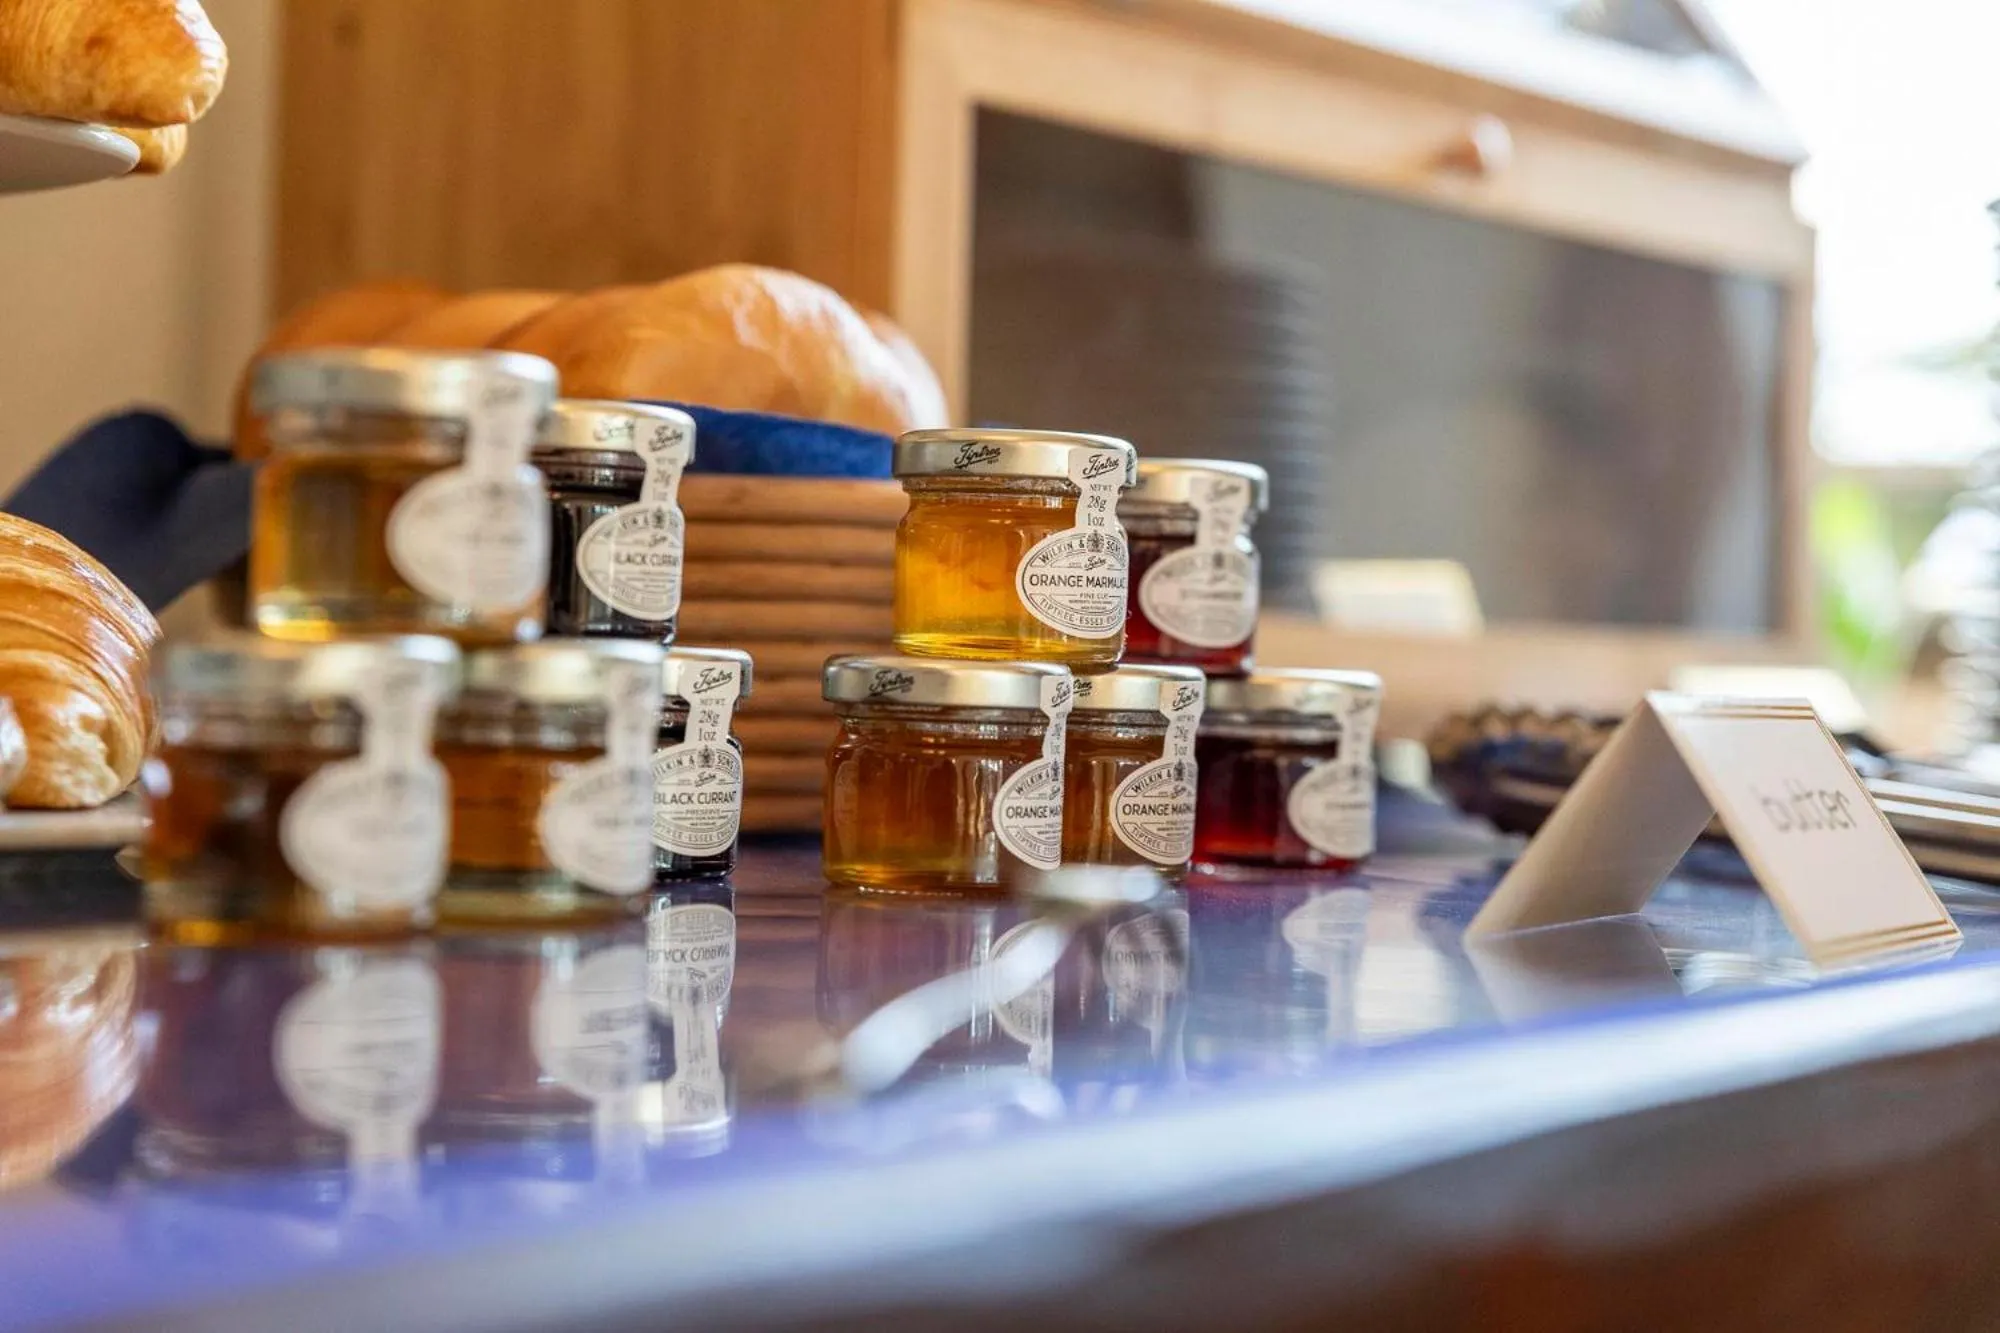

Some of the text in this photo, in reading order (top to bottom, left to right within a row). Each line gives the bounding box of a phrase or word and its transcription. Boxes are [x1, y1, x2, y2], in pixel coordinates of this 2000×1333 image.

[954, 441, 1001, 469] Tiptree
[1081, 454, 1120, 479] Tiptree
[1088, 495, 1107, 512] 28g
[1088, 513, 1105, 526] 1oz
[1039, 541, 1073, 563] WILKIN
[1029, 574, 1083, 587] ORANGE
[1040, 598, 1074, 622] TIPTREE
[693, 667, 733, 693] Tiptree
[699, 709, 720, 727] 28g
[699, 728, 716, 741] 1oz
[1131, 773, 1162, 793] WILKIN
[653, 791, 694, 805] BLACK
[1751, 778, 1857, 834] butter
[1006, 806, 1048, 819] ORANGE
[1122, 803, 1169, 816] ORANGE
